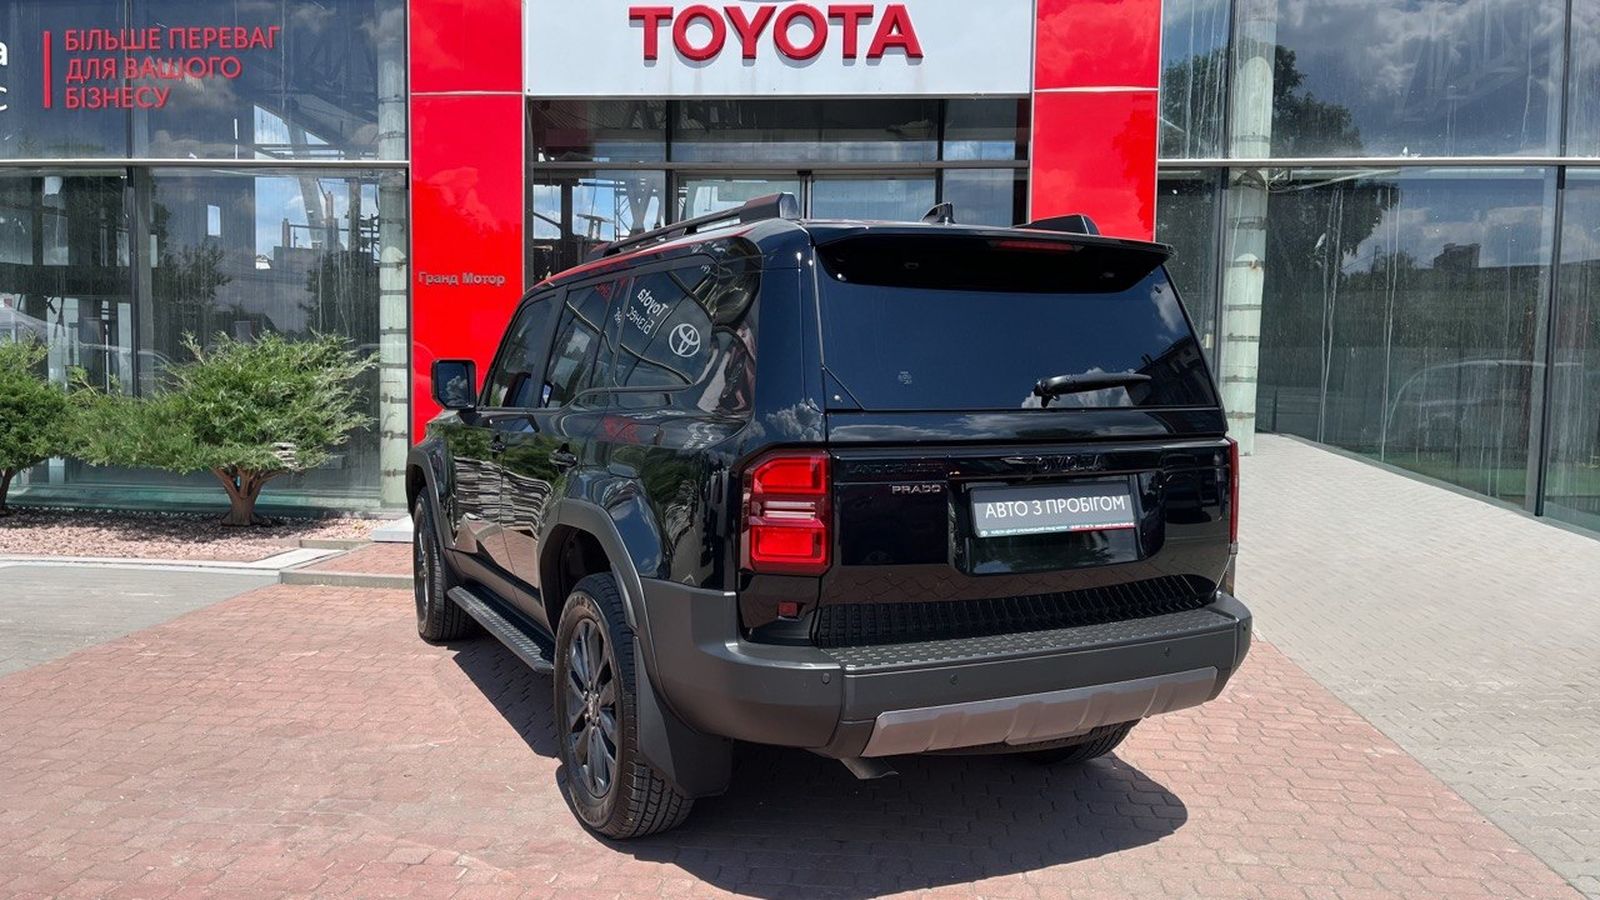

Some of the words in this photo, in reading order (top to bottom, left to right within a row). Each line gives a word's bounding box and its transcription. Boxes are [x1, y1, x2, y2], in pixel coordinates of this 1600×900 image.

[64, 27, 161, 51] БІЛЬШЕ
[169, 26, 281, 49] ПЕРЕВАГ
[628, 4, 924, 60] TOYOTA
[65, 58, 117, 84] ДЛЯ
[124, 56, 242, 80] ВАШОГО
[65, 86, 171, 109] БІЗНЕСУ
[418, 271, 459, 286] Гранд
[462, 272, 506, 286] Мотор
[891, 484, 941, 495] PRADO
[985, 500, 1029, 519] АВТО
[1045, 495, 1126, 515] ПРОБІГОМ
